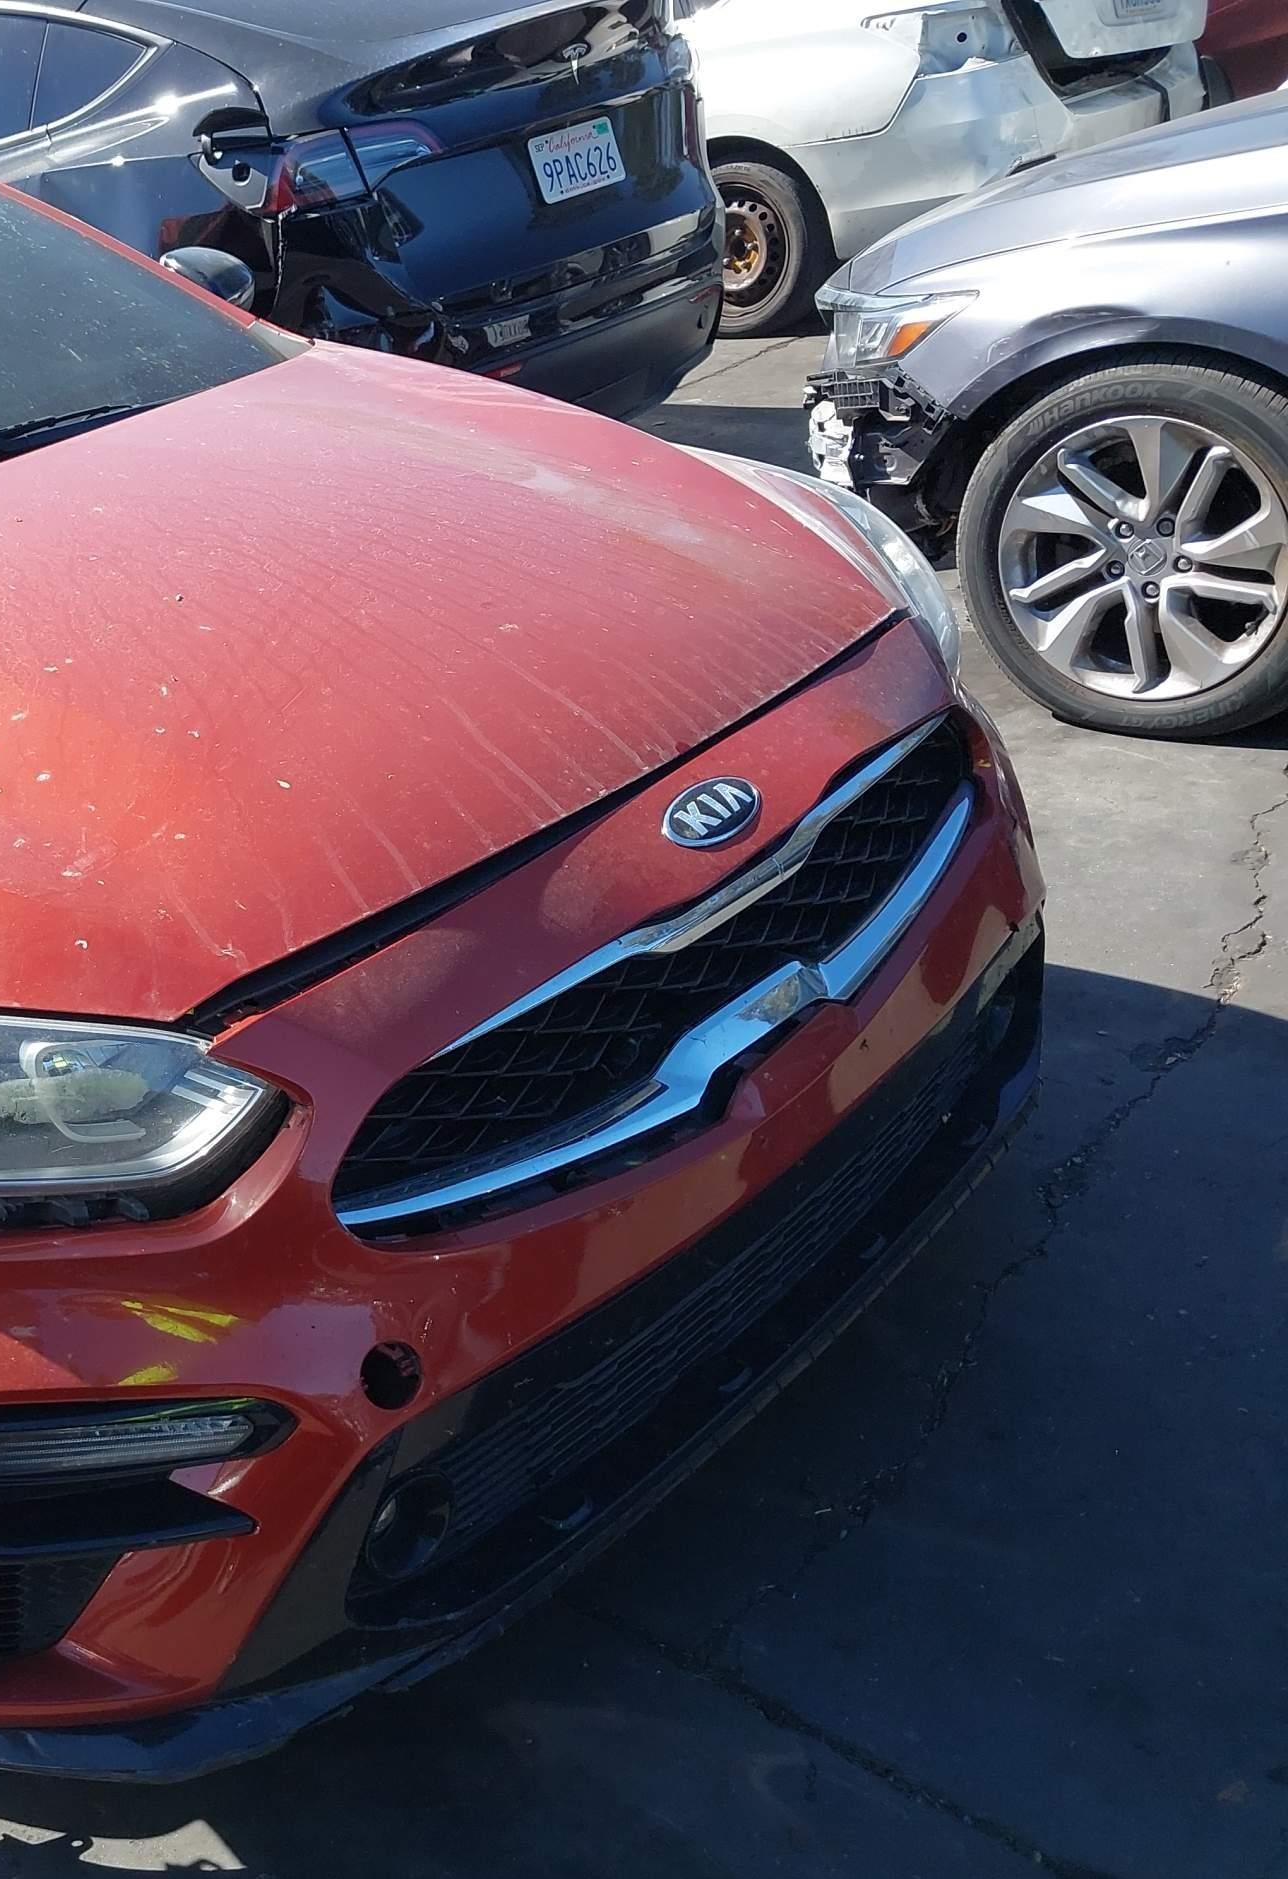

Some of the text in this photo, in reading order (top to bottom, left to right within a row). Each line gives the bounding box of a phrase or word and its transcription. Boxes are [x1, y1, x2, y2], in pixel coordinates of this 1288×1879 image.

[543, 142, 617, 192] 9PAC626
[548, 130, 599, 154] California
[673, 782, 753, 836] KIA
